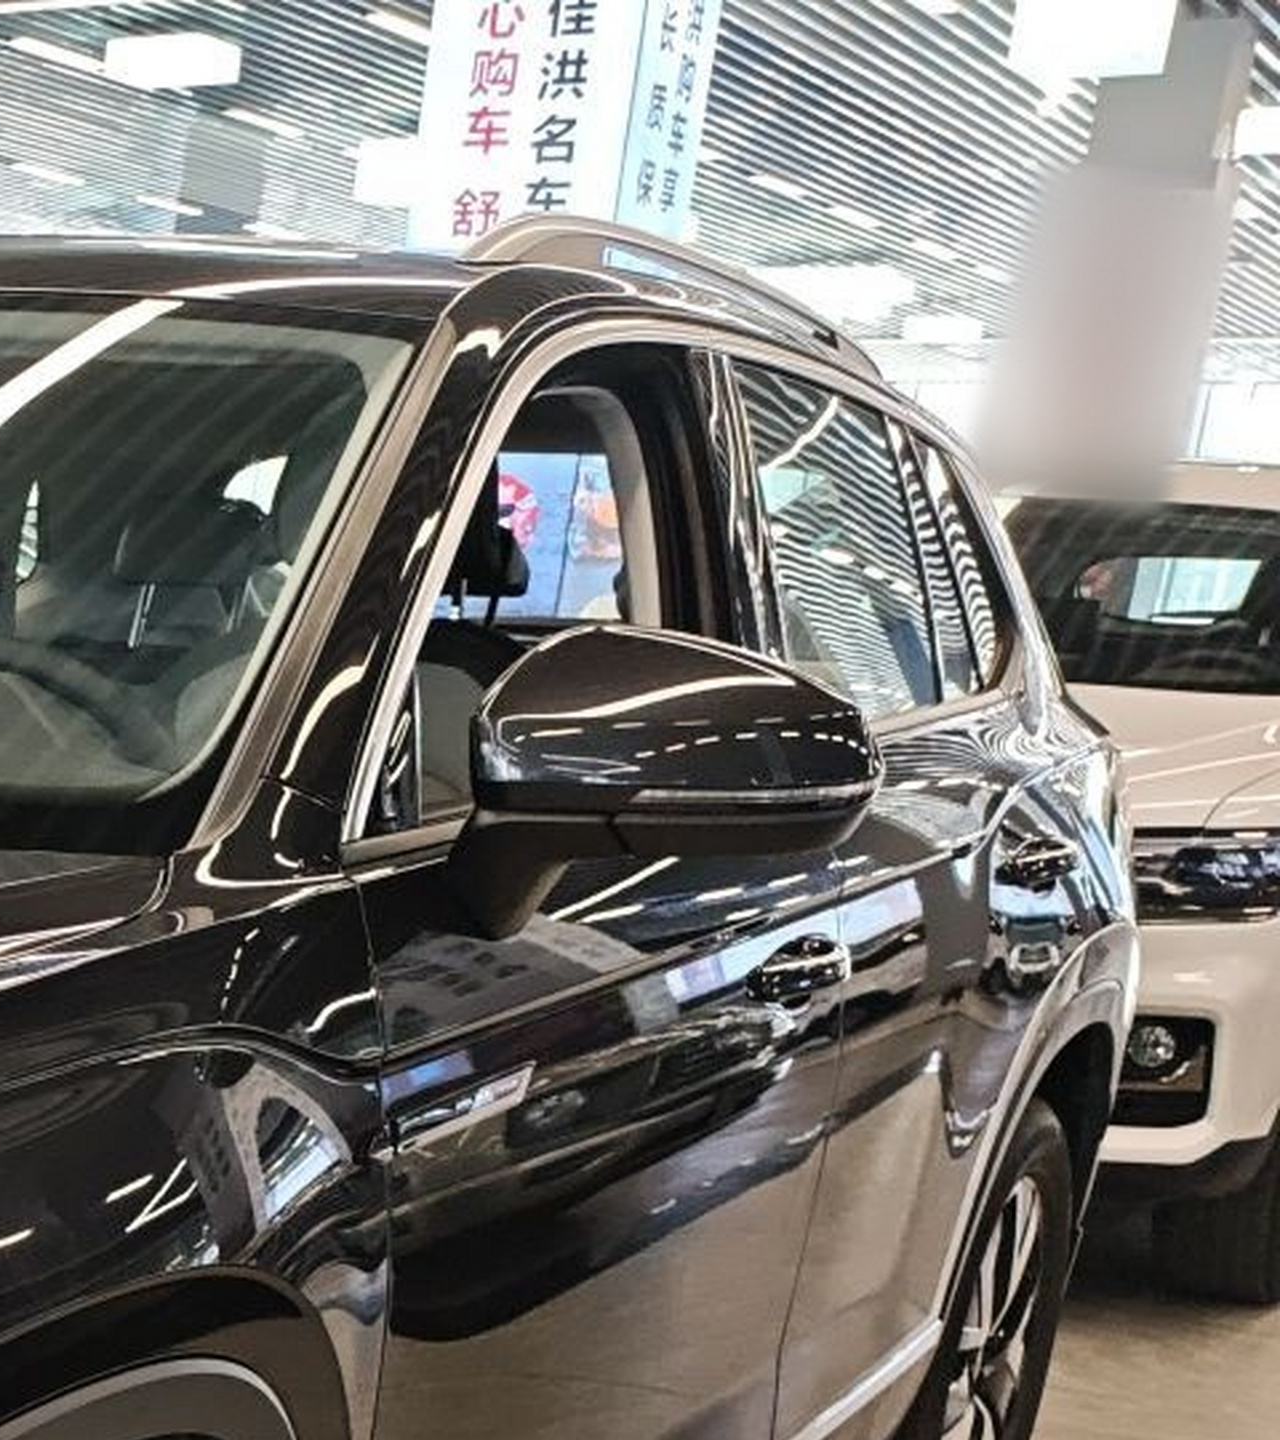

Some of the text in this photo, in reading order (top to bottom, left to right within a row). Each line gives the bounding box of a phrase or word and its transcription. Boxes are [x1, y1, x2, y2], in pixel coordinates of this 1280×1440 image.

[452, 0, 525, 238] 心购车 舒
[525, 0, 599, 212] 佳洪名车
